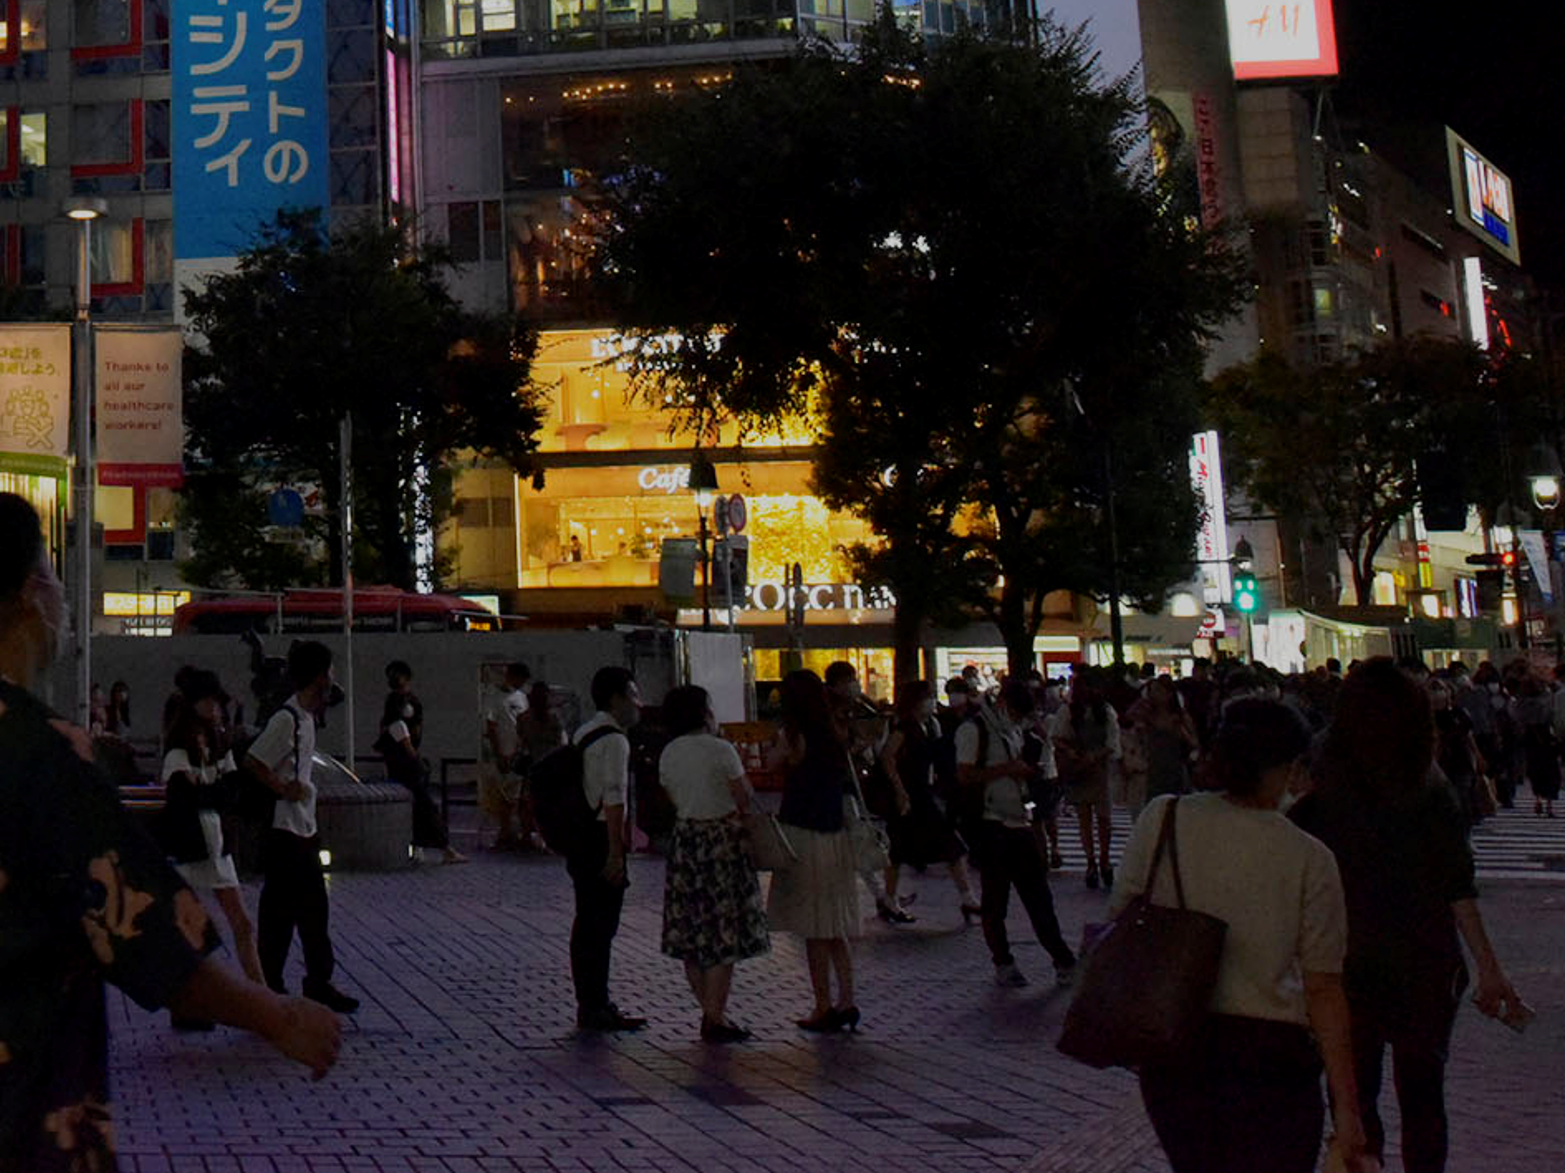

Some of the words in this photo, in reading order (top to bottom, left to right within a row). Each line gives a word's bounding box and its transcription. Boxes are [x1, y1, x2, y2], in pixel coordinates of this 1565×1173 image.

[105, 361, 152, 372] Thanks
[156, 361, 169, 372] to
[104, 401, 175, 412] healthcare
